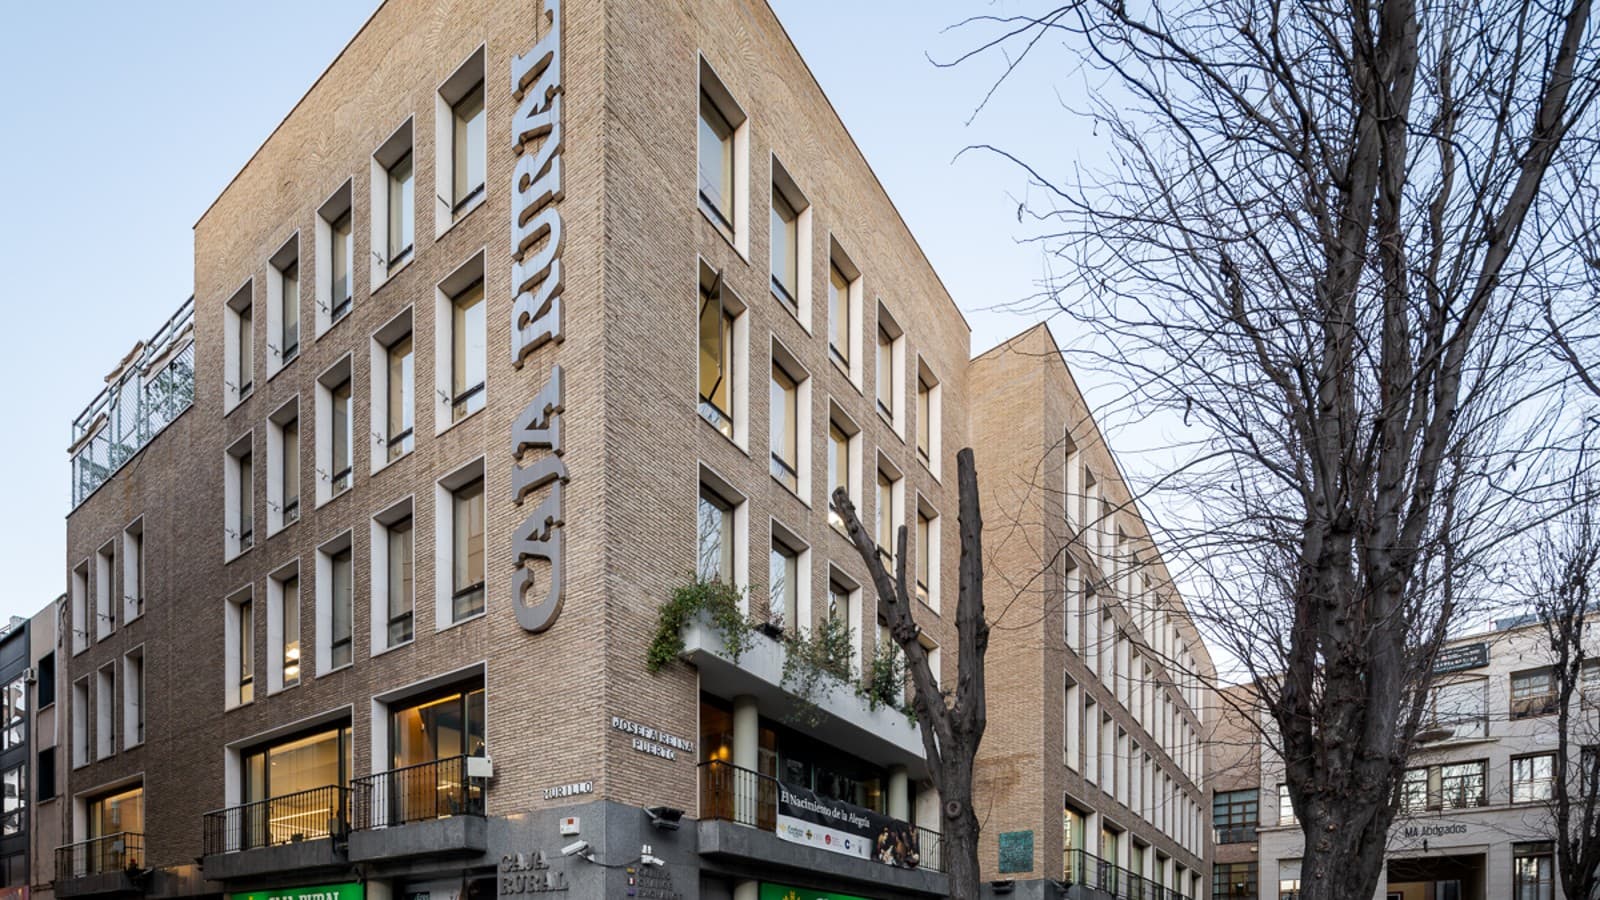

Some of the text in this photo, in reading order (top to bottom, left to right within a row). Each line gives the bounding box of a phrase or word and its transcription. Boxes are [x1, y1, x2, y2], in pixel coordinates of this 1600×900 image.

[511, 0, 568, 633] CAJA RURAL
[612, 716, 694, 753] JOSEFA REINA
[632, 738, 677, 761] PUERTO
[543, 781, 593, 800] MURILLO
[781, 790, 789, 804] El
[790, 794, 832, 817] Nacimiento
[832, 807, 840, 819] de
[841, 808, 848, 821] la
[1405, 824, 1467, 838] MA Abogados
[501, 850, 550, 873] CAJA
[500, 872, 569, 895] RURAL
